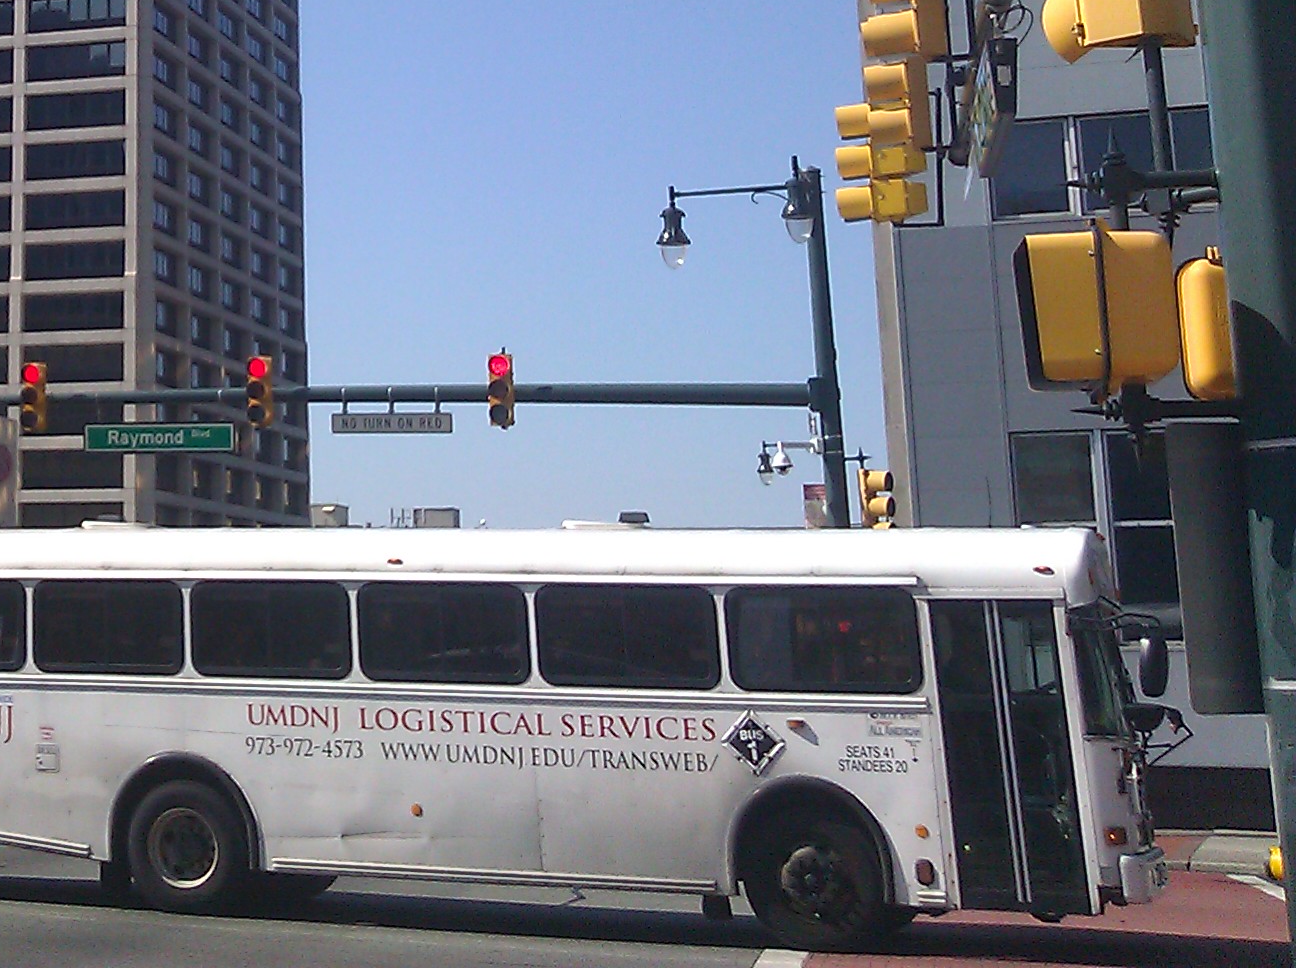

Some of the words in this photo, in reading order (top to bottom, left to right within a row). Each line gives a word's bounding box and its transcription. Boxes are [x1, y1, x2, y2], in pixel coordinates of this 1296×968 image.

[341, 417, 357, 429] NO
[364, 417, 391, 429] TURN
[397, 417, 413, 429] ON
[419, 417, 442, 429] RED
[108, 430, 184, 447] Raymond
[246, 702, 340, 734] UMDNJ
[358, 707, 552, 736] LOGISTICAL
[560, 713, 717, 741] SERVICES
[739, 729, 764, 741] BUS
[245, 736, 364, 759] 973-972-4573
[747, 740, 759, 761] 1
[845, 745, 880, 758] SEATS
[882, 746, 895, 758] 41
[838, 758, 894, 773] STANDEES
[895, 759, 908, 773] 20
